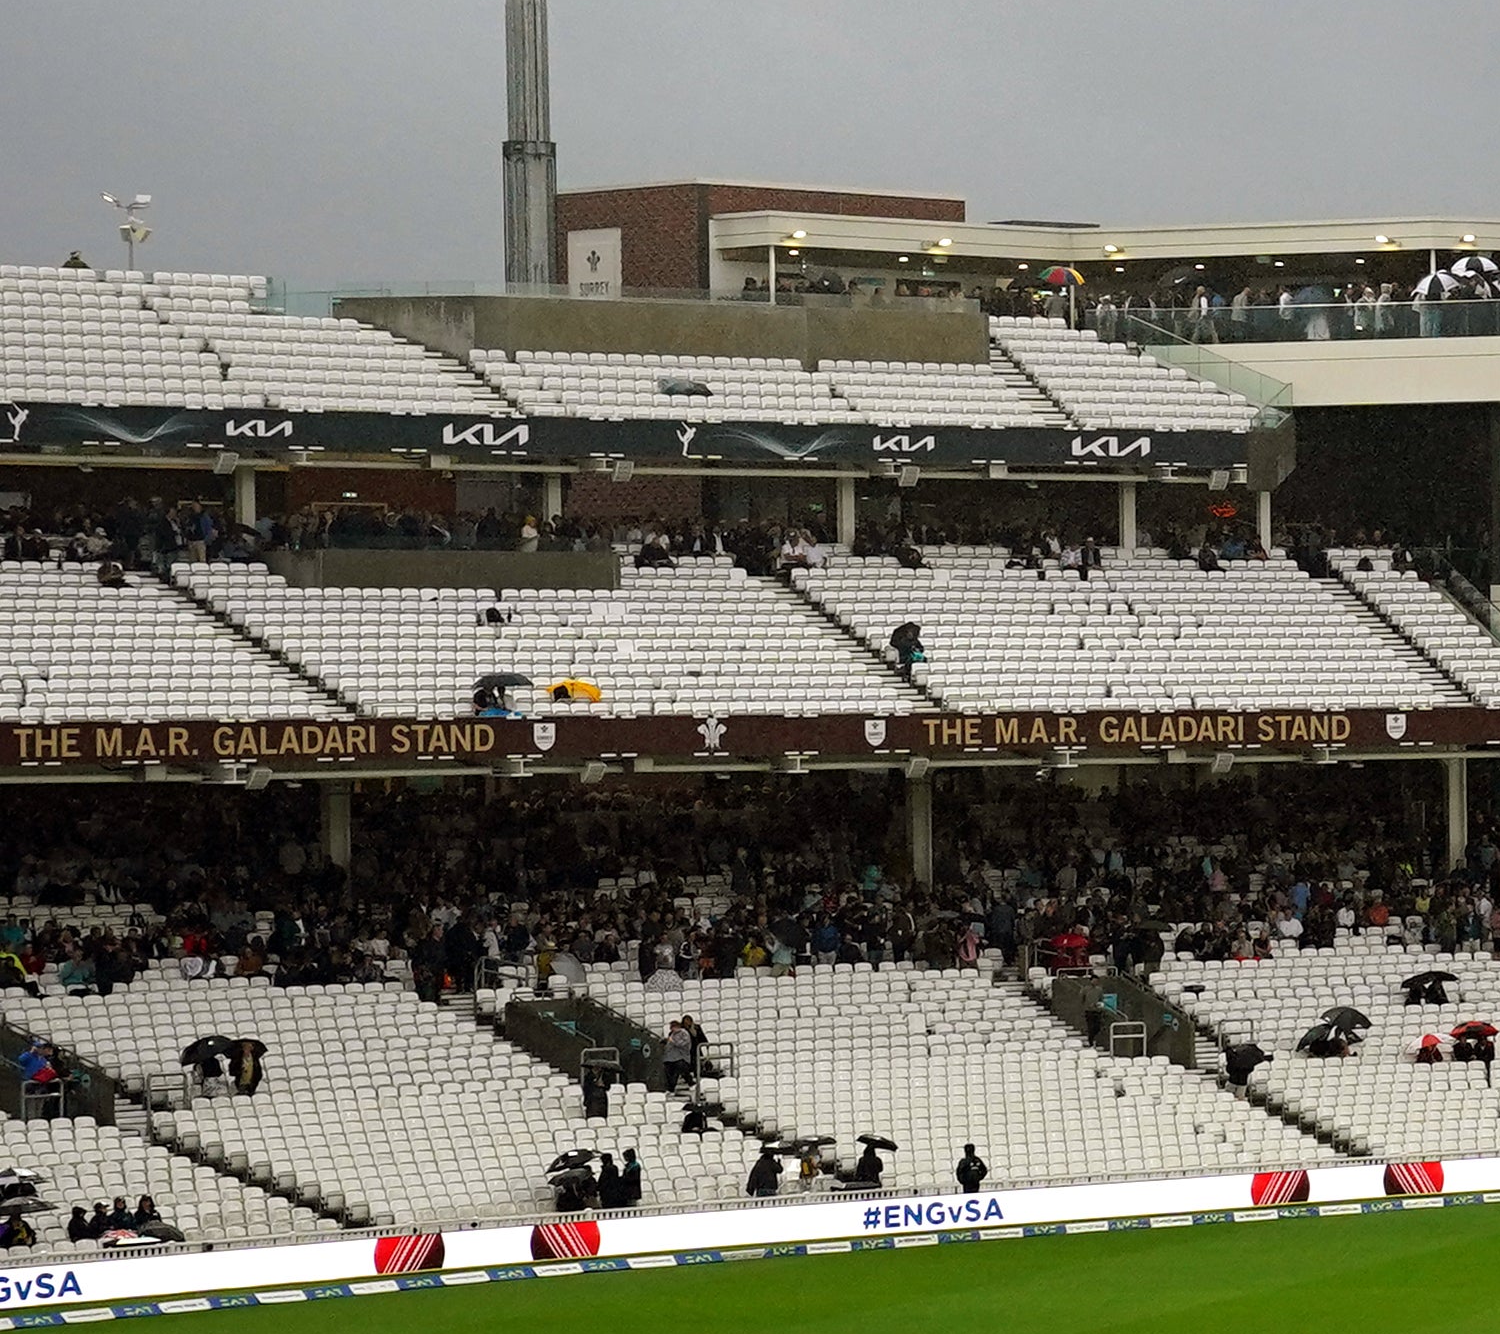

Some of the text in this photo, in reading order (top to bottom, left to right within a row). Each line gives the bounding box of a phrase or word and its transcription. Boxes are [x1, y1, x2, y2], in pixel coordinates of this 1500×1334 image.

[13, 723, 496, 759] THE M.A.R. GALADARI STAND
[924, 714, 1352, 747] THE M.A.R. GALADARI STAND
[863, 1198, 1003, 1229] #ENGvSA
